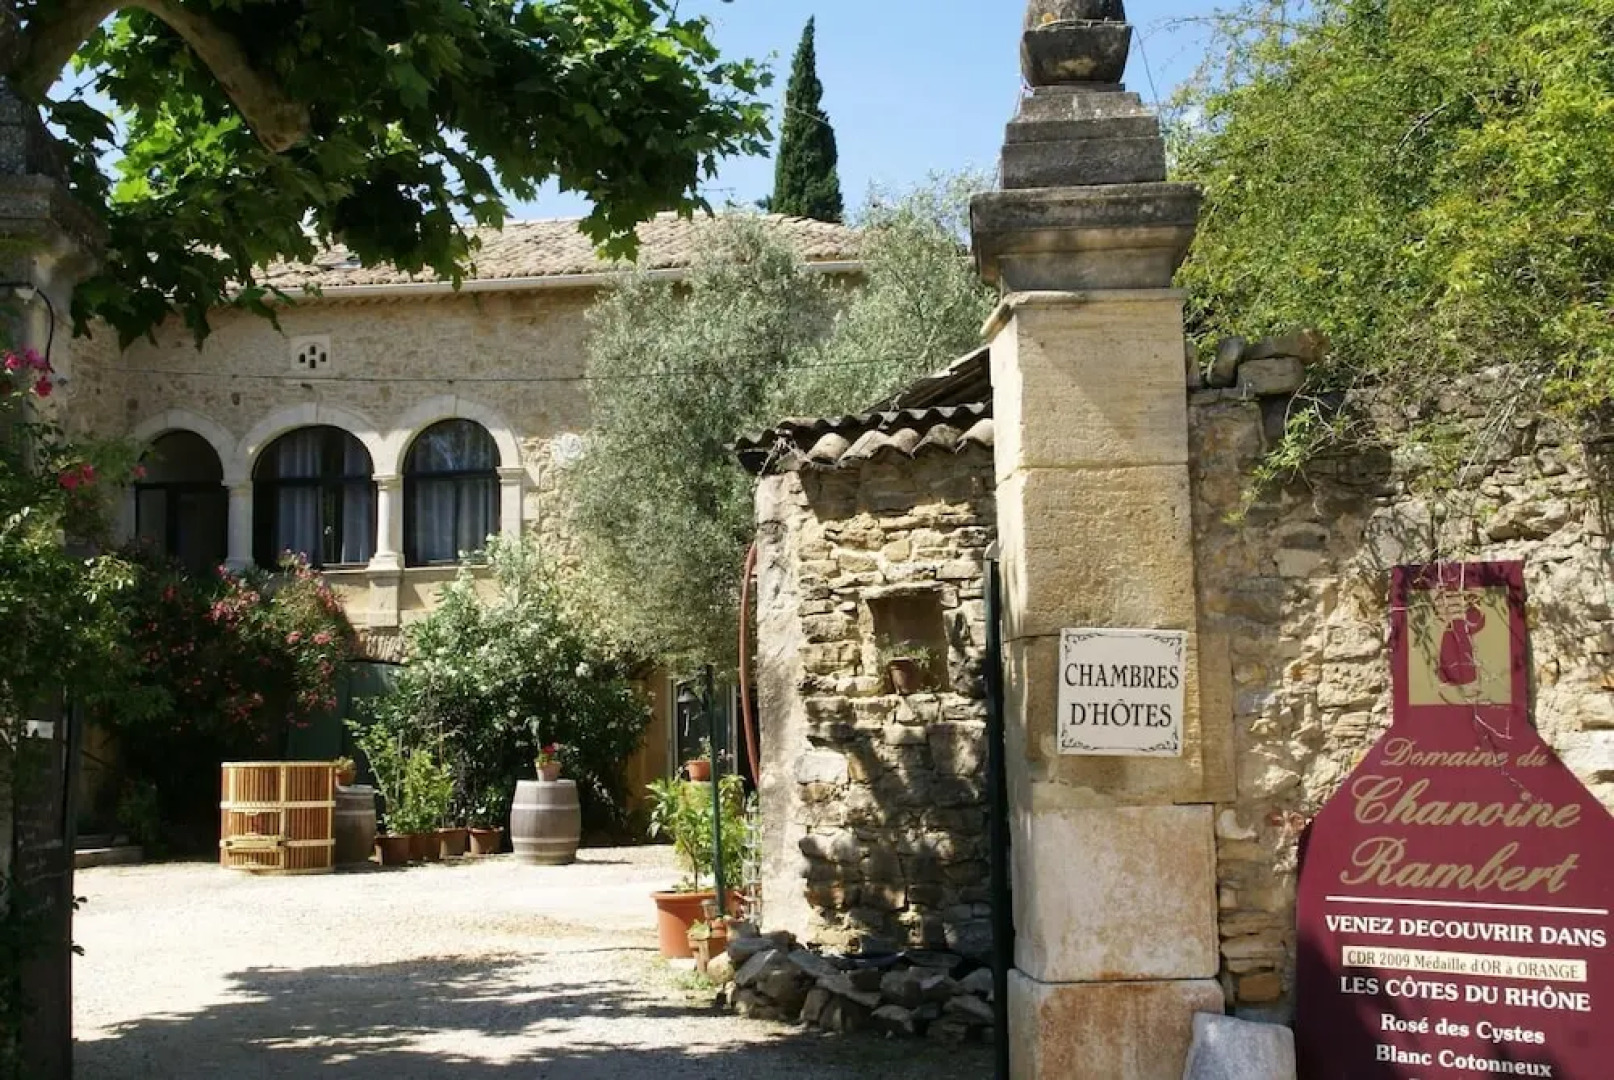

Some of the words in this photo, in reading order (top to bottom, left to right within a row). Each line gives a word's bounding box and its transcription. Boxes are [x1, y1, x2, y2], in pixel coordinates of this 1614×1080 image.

[1064, 662, 1179, 689] CHAMBRES
[1070, 698, 1172, 728] D'HÔTES
[1380, 737, 1508, 768] Domaine
[1516, 744, 1548, 768] du
[1351, 775, 1581, 829] Chanoine
[1340, 836, 1580, 892] Rambert
[1325, 915, 1394, 935] VENEZ
[1400, 918, 1534, 944] DECOUVRIR
[1540, 926, 1607, 948] DANS
[1347, 950, 1375, 965] CDR
[1379, 952, 1410, 967] 2009
[1414, 955, 1467, 971] Médaille
[1517, 962, 1579, 979] ORANGE
[1341, 975, 1379, 995] LES
[1386, 974, 1458, 1002] CÔTES
[1465, 984, 1499, 1004] DU
[1505, 985, 1591, 1012] RHÔNE
[1381, 1013, 1429, 1034] Rosé
[1435, 1018, 1470, 1037] des
[1476, 1021, 1546, 1044] Cystes
[1376, 1044, 1433, 1066] Blanc
[1438, 1050, 1552, 1078] Cotonneux
